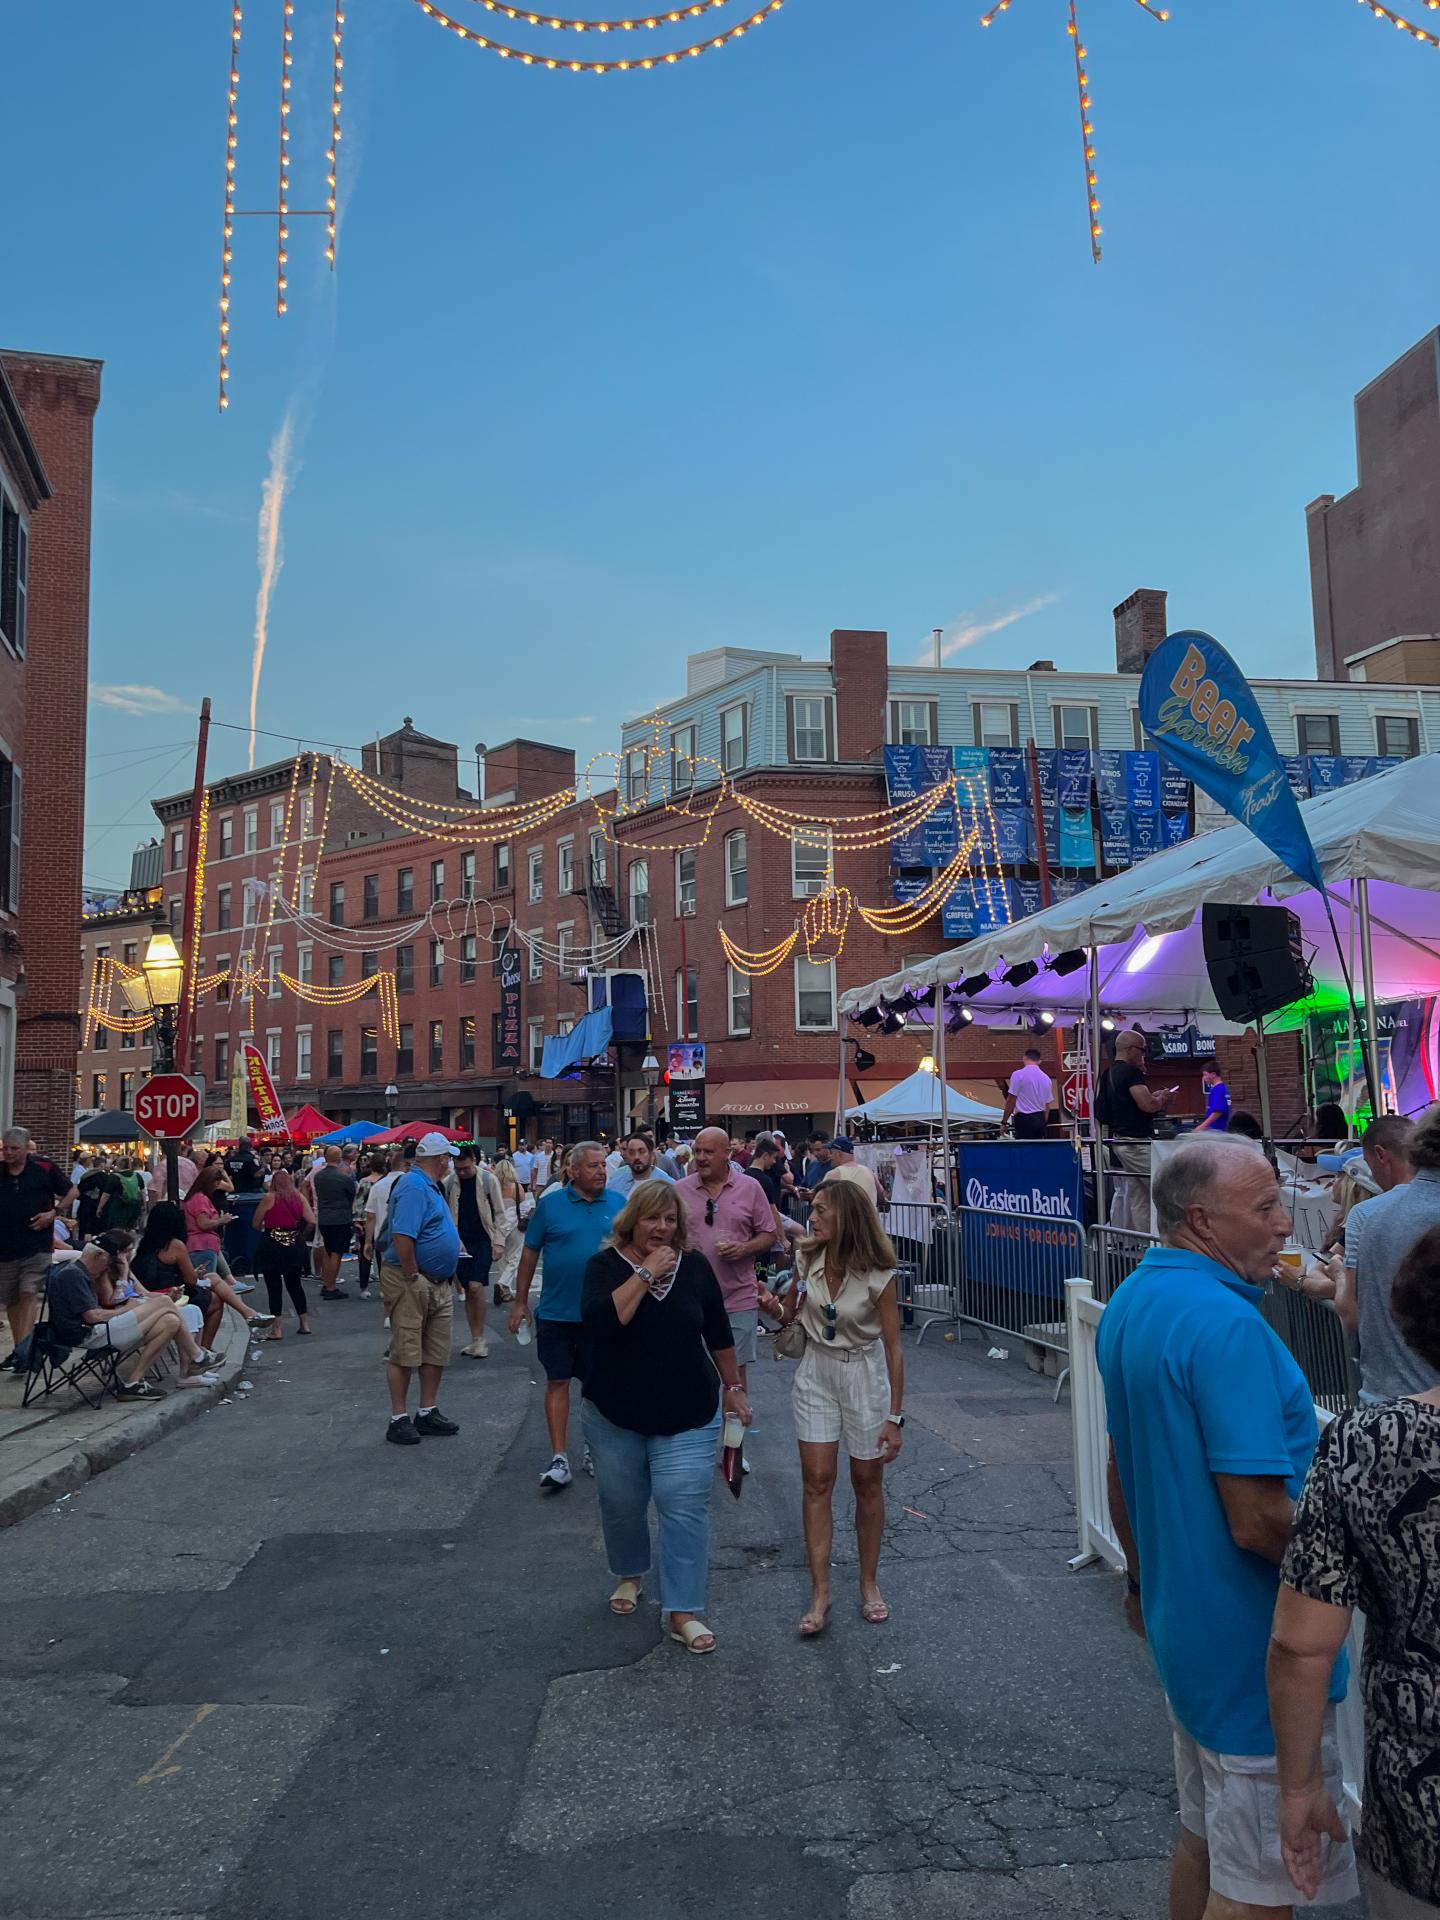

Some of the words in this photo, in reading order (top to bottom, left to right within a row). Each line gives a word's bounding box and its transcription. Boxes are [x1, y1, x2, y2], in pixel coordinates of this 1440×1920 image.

[1170, 643, 1255, 759] Beer
[1153, 696, 1249, 775] Garden
[502, 992, 519, 1057] PIZZA
[139, 1094, 196, 1119] STOP
[774, 1102, 809, 1111] NIDO
[982, 1185, 1031, 1213] Eastern
[1031, 1188, 1073, 1216] Bank
[1024, 1227, 1042, 1244] FOR
